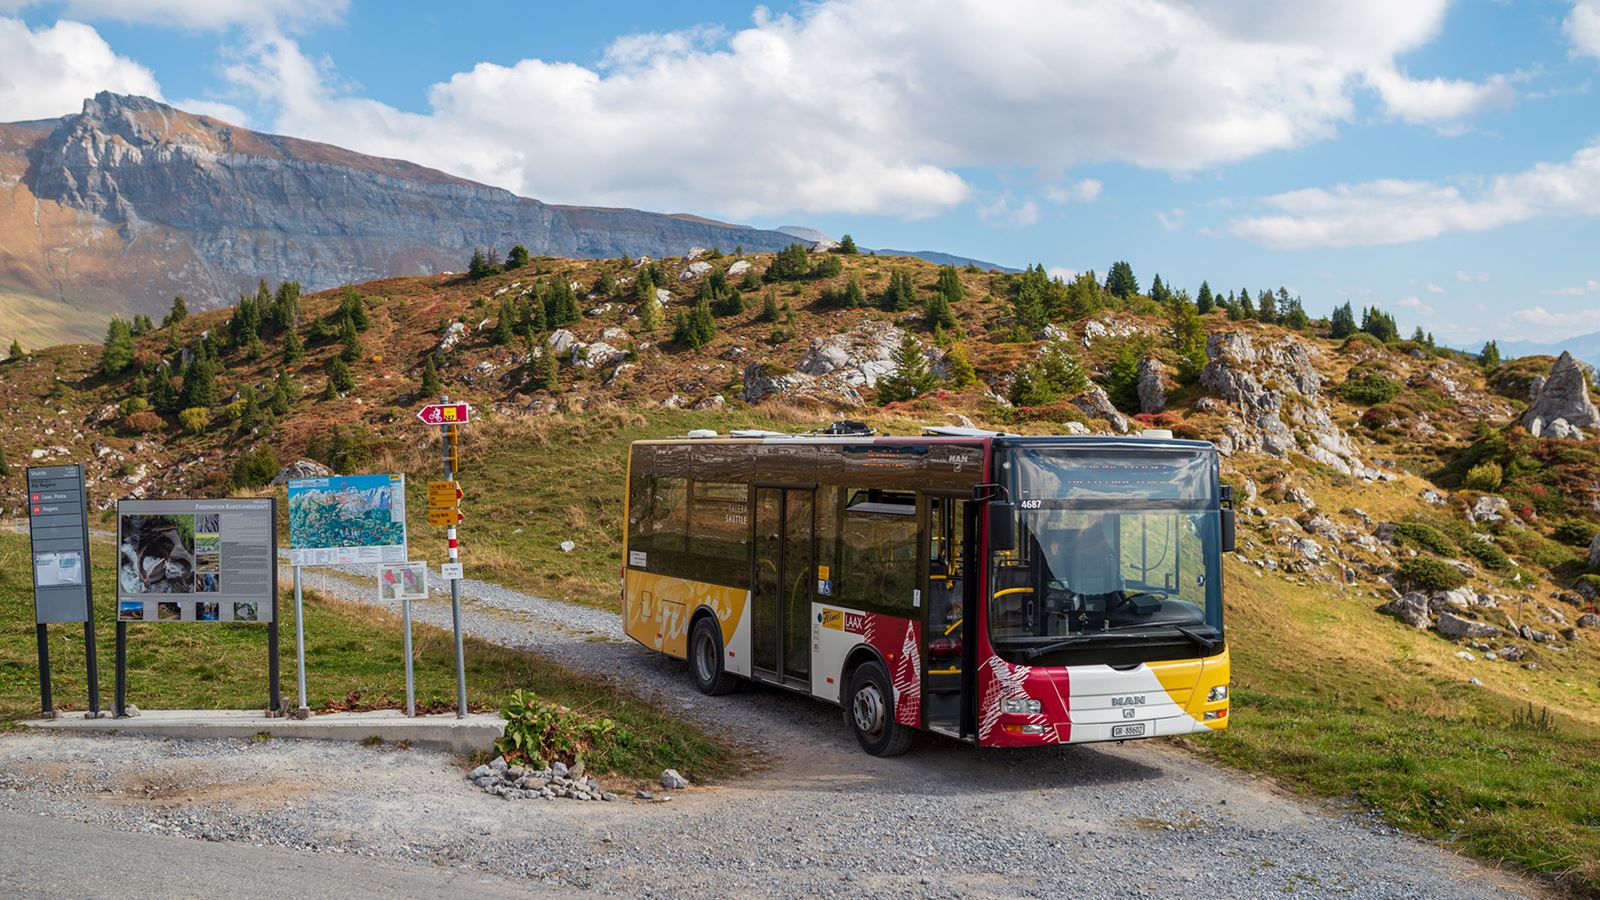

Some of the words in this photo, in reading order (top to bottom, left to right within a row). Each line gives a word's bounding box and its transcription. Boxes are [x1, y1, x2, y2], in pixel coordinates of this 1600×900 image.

[948, 455, 968, 463] MAN
[1021, 500, 1042, 509] 4687
[725, 514, 747, 525] SHUTTLE
[845, 614, 863, 630] LAAX
[1111, 696, 1146, 706] MAN
